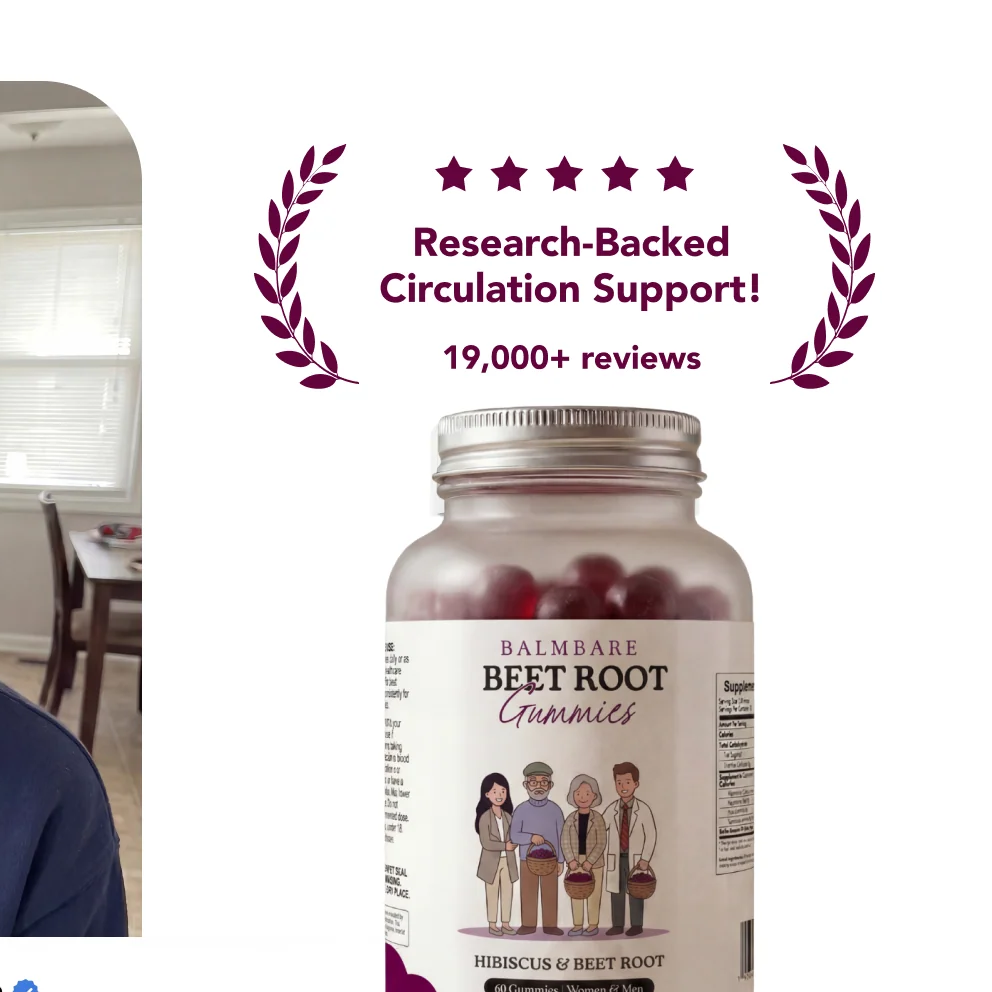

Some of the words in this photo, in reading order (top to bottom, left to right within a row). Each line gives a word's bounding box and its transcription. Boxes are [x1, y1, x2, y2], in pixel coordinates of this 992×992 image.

[500, 639, 638, 656] BALMBARE
[482, 664, 567, 692] BEET
[573, 664, 669, 692] ROOT
[498, 681, 637, 729] Gummies
[474, 954, 552, 971] HIBISCUS
[555, 956, 570, 971] &
[573, 956, 617, 971] BEET
[620, 954, 665, 970] ROOT
